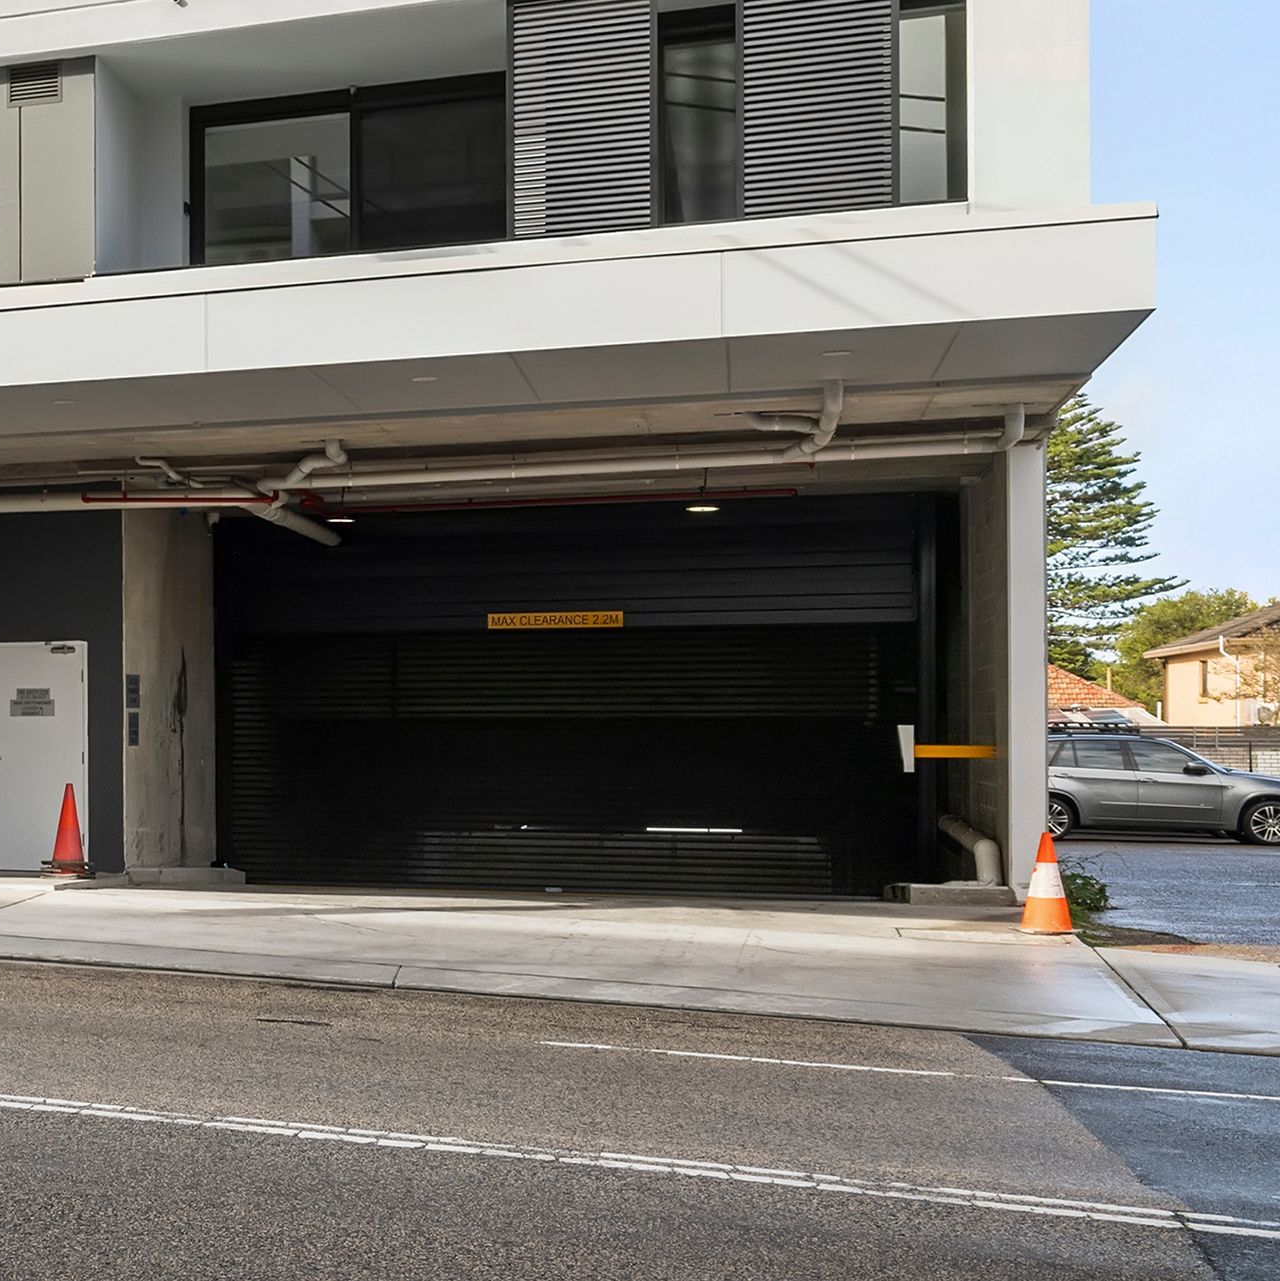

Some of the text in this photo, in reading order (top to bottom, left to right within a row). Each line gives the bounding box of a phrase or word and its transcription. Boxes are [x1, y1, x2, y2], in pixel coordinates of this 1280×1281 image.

[491, 613, 619, 627] MAX CLEARANCE 2.2M
